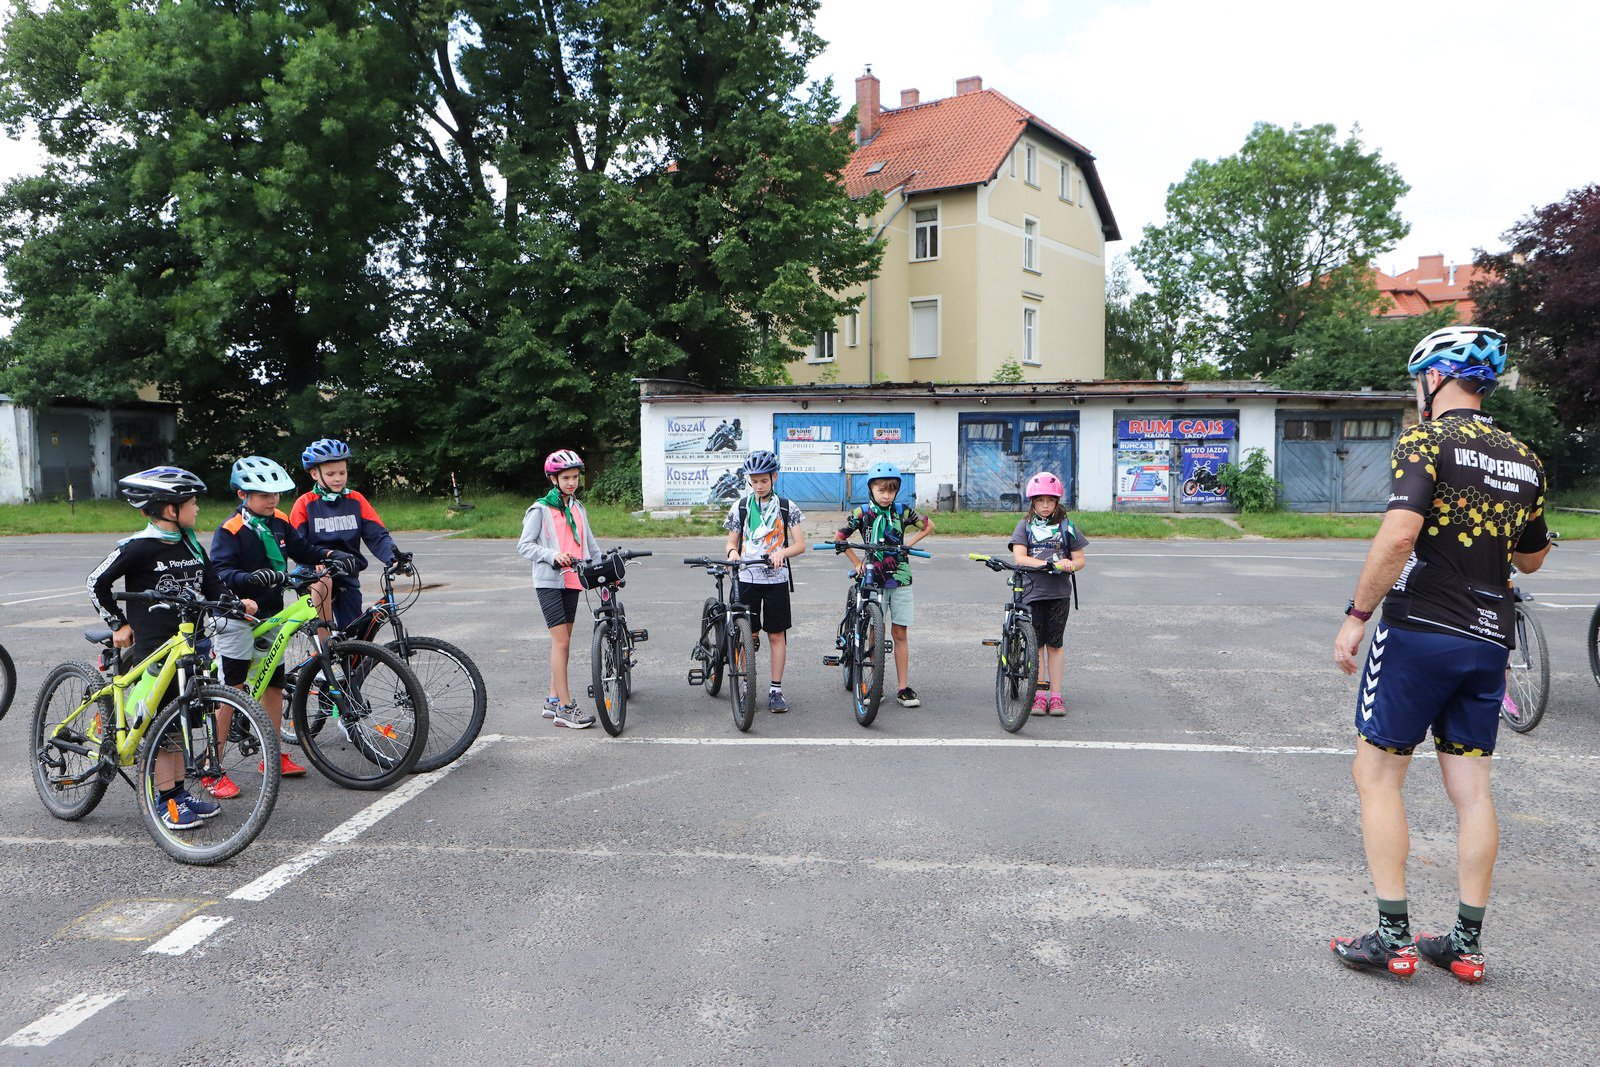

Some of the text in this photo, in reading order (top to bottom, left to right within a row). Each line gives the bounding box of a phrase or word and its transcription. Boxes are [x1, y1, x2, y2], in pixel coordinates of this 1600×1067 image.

[668, 418, 706, 432] KOSZAK
[1128, 420, 1224, 435] RUM CAJS
[1454, 448, 1478, 468] UKS
[667, 466, 709, 480] KOSZAK
[1502, 481, 1519, 493] GÓRA
[314, 515, 358, 533] PUMA
[252, 633, 285, 697] ROCKRIDER
